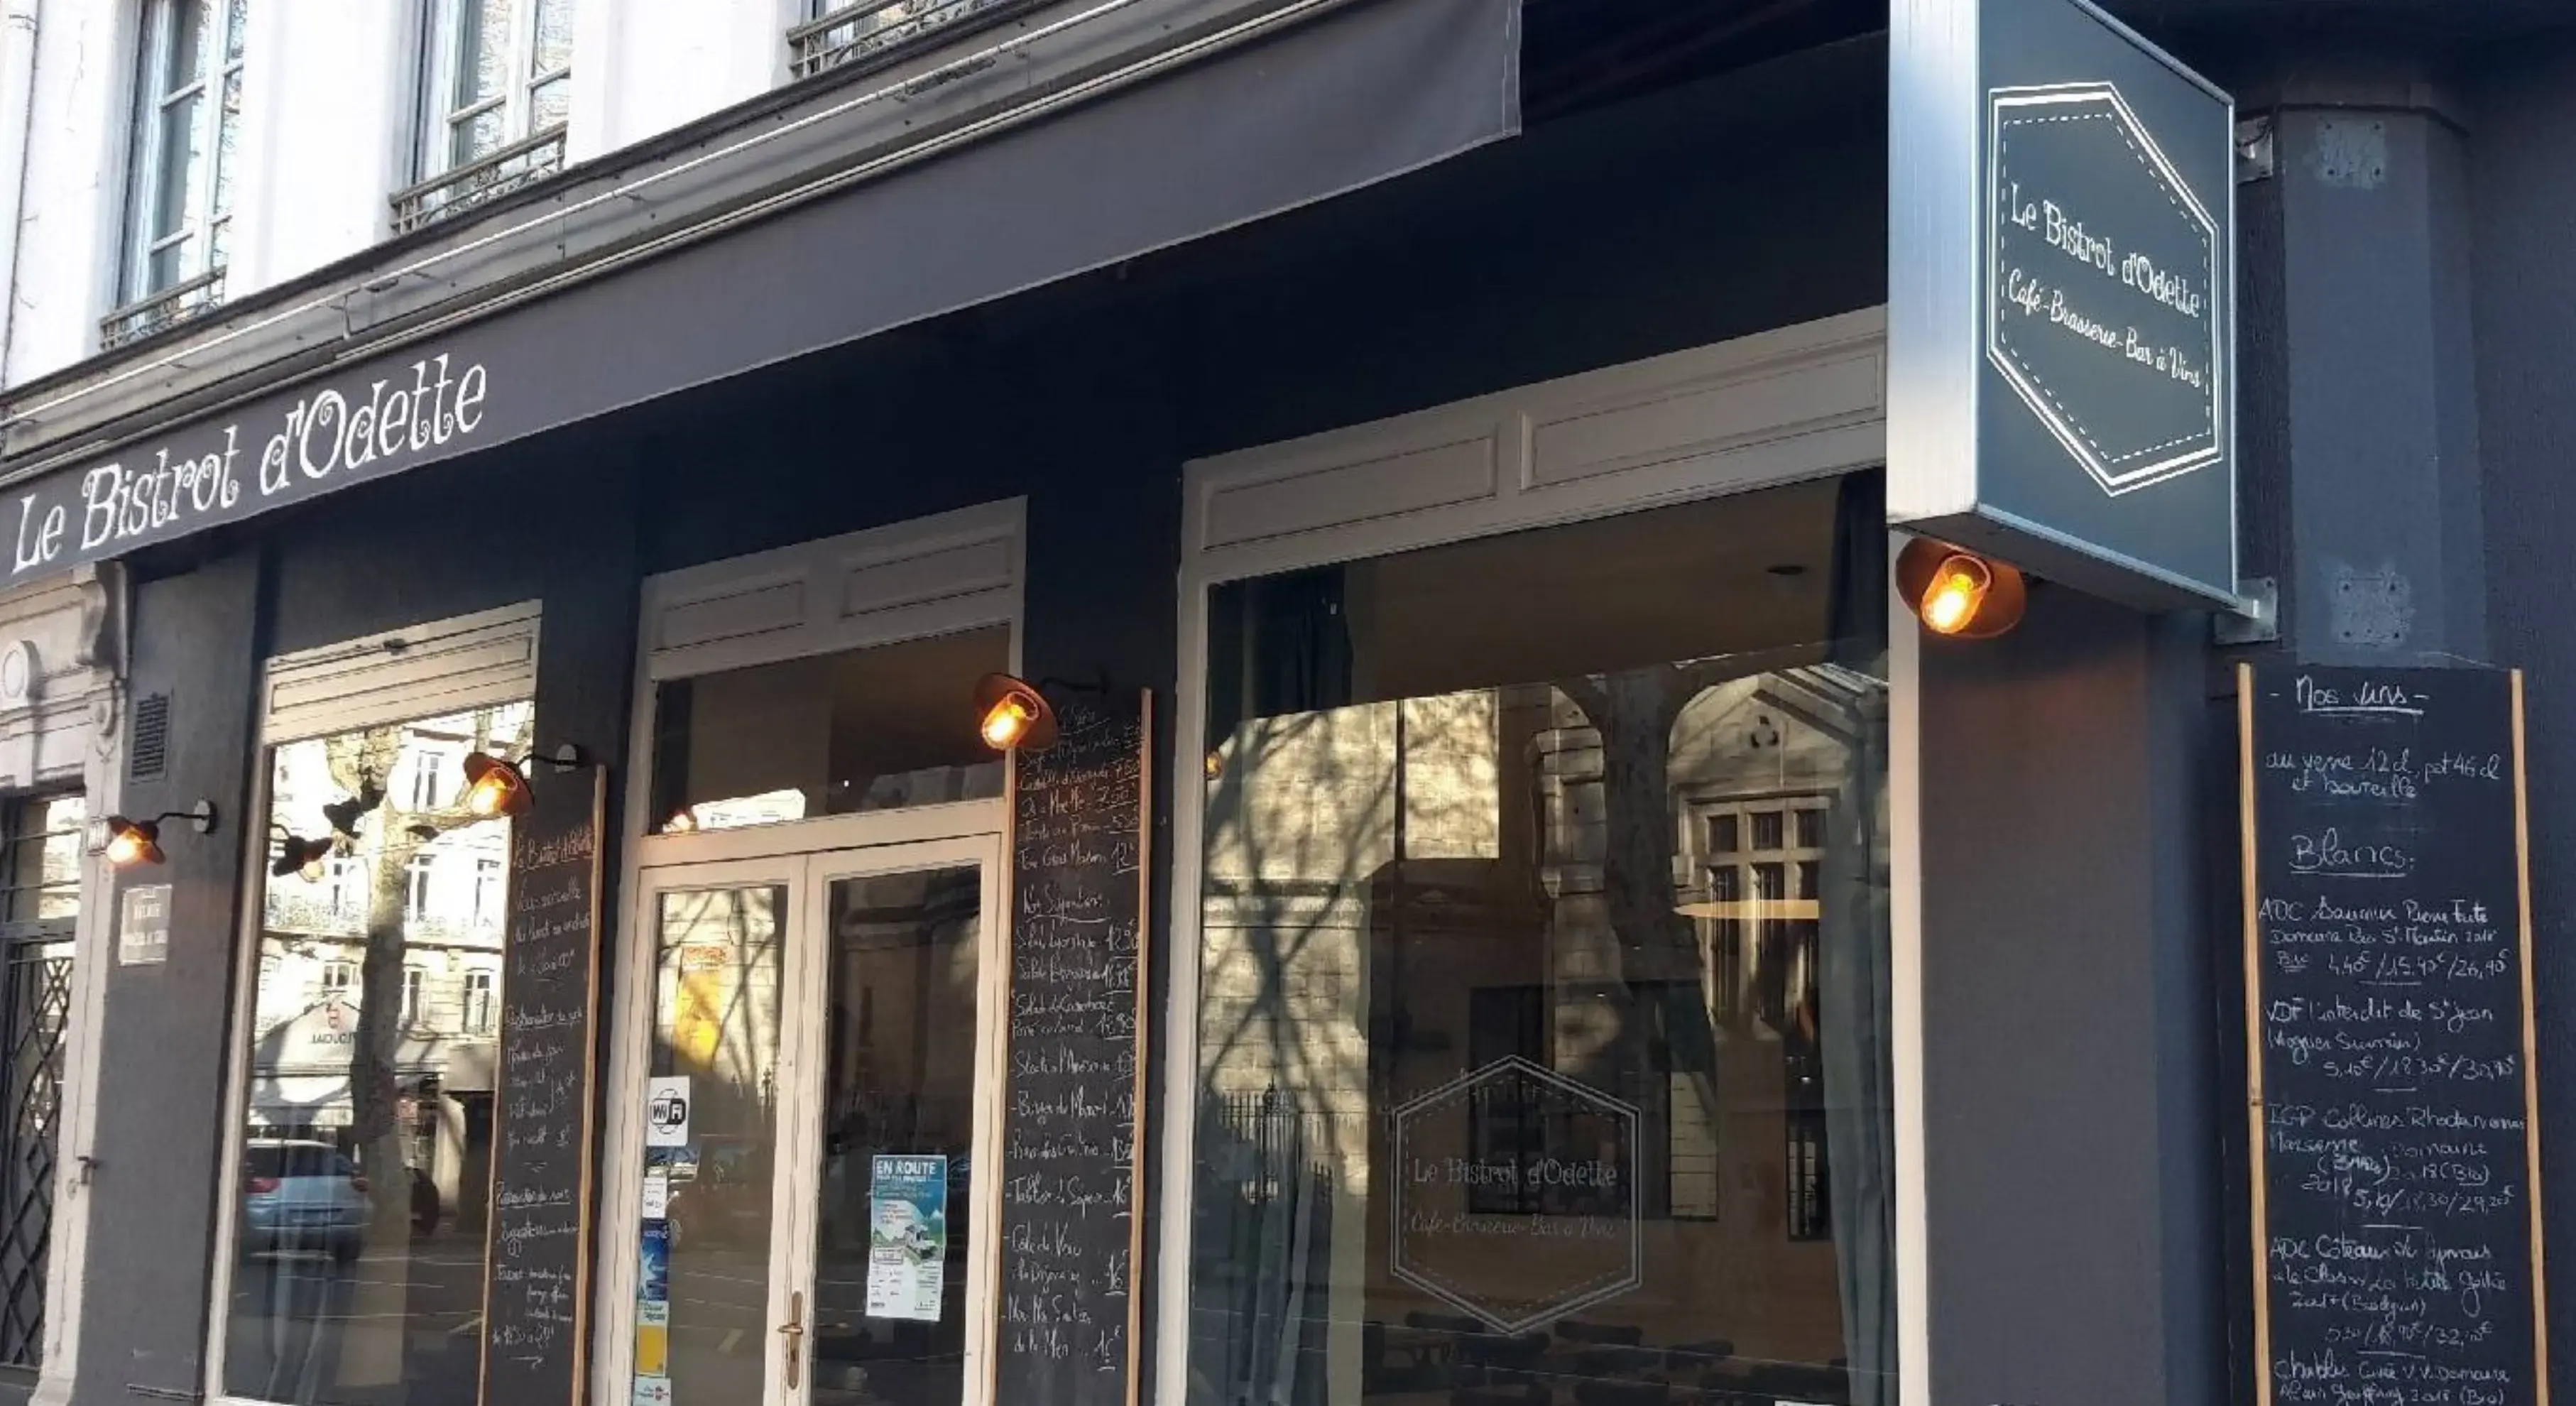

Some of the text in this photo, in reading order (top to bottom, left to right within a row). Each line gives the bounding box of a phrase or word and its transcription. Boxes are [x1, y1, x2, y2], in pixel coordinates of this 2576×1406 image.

[2010, 181, 2200, 318] Le Bistrot d'Odette
[2170, 347, 2200, 388] Vins
[12, 353, 488, 574] Le Bistrot d'Odette
[2296, 675, 2339, 710] Nos
[876, 1160, 893, 1175] EN
[1413, 1158, 1438, 1183] Le
[1446, 1156, 1518, 1185] Bistrot
